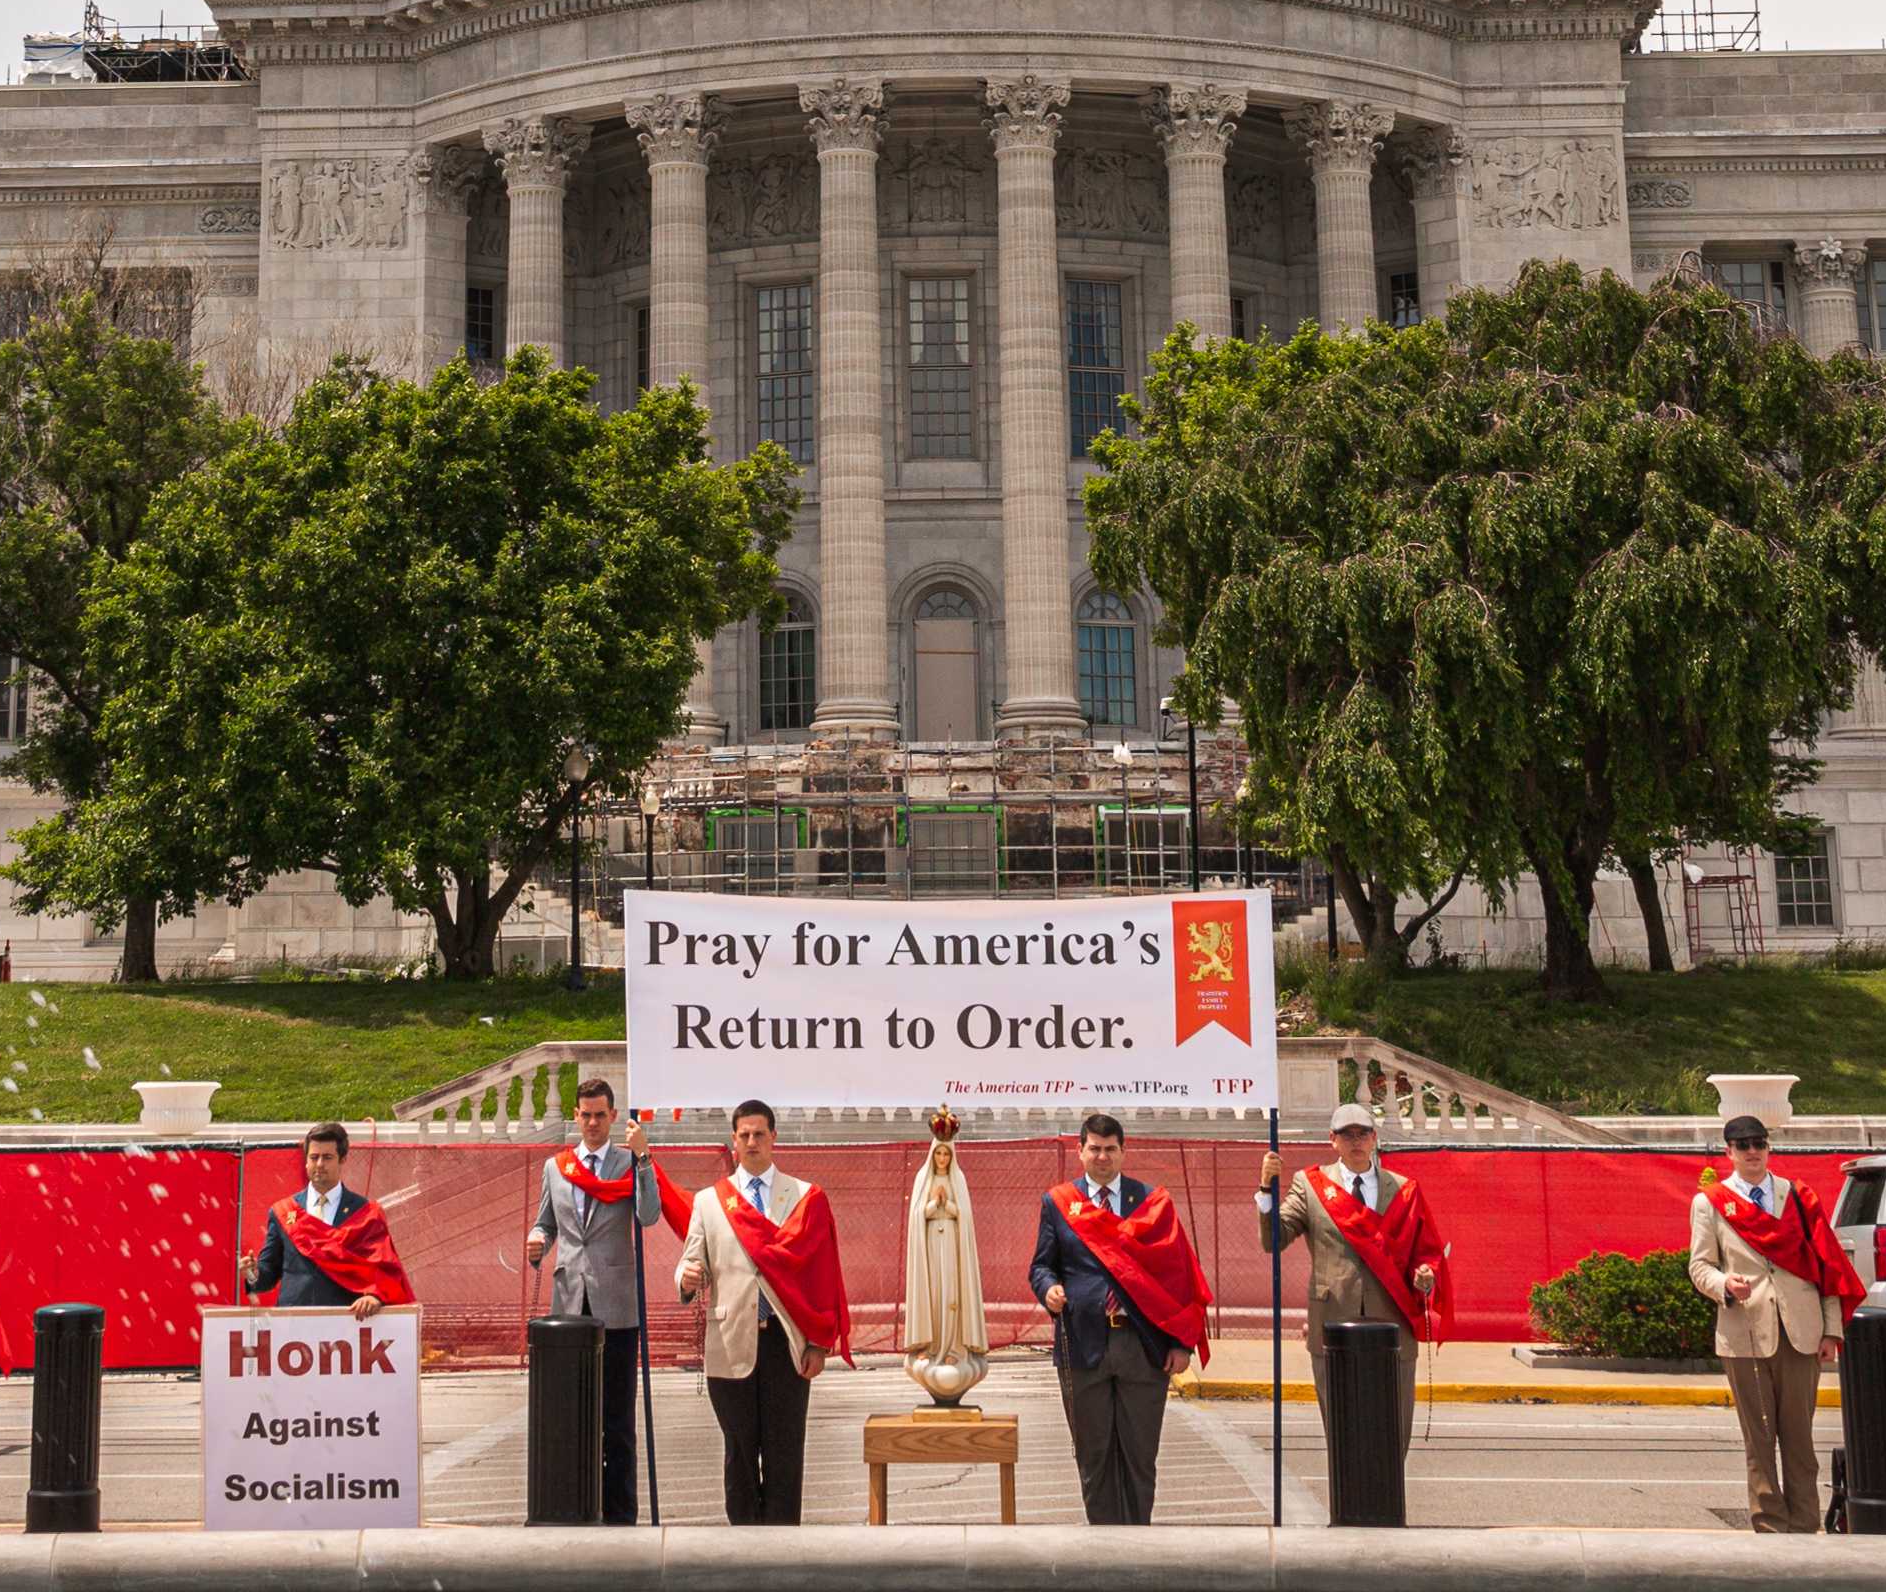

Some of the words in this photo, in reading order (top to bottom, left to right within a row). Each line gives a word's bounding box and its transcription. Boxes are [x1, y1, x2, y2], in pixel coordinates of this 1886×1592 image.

[645, 920, 772, 979] Pray
[791, 921, 872, 966] for
[885, 920, 1161, 966] America’s
[672, 1004, 864, 1050] Return
[884, 1007, 935, 1050] to
[956, 1003, 1134, 1050] Order.
[945, 1080, 972, 1094] The
[974, 1080, 1039, 1094] American
[1044, 1080, 1075, 1094] TFP
[1094, 1080, 1189, 1096] www.TFP.org
[1212, 1078, 1254, 1094] TFP
[229, 1326, 397, 1378] Honk
[242, 1410, 381, 1446] Against
[224, 1472, 400, 1502] Socialism
